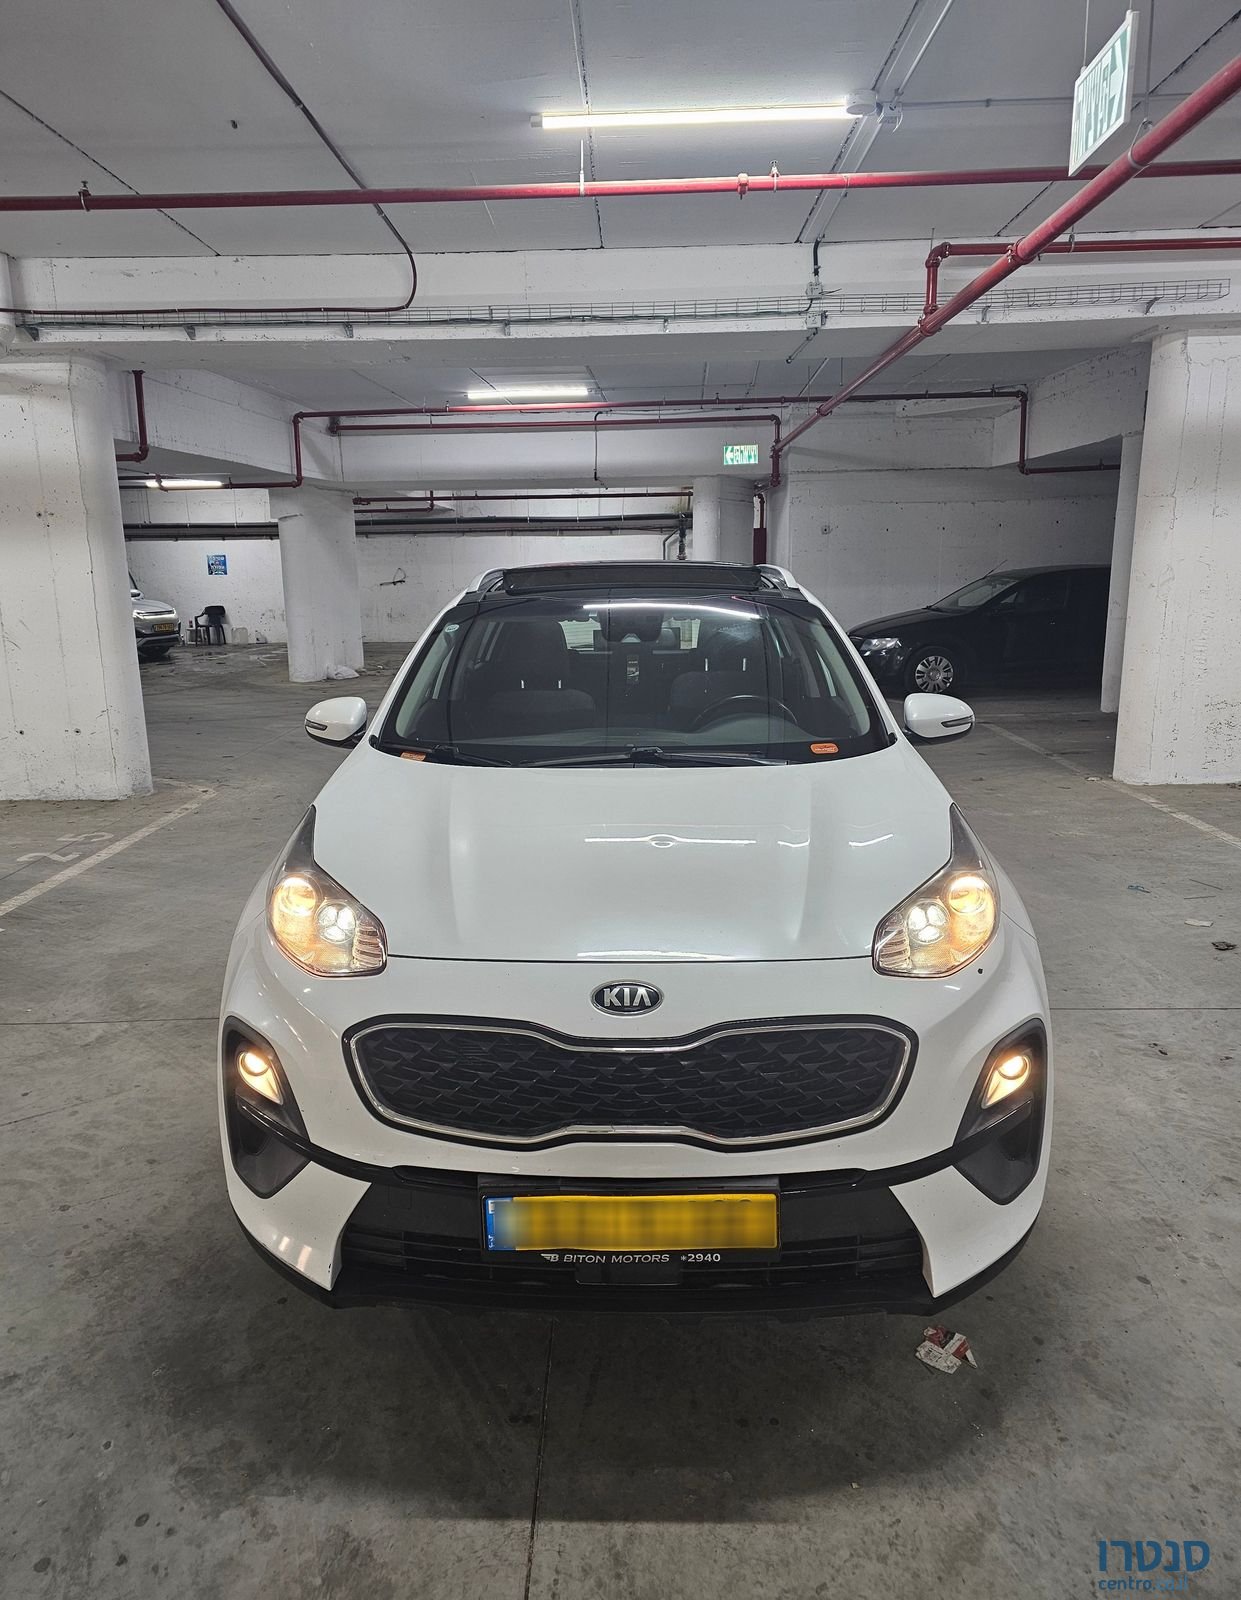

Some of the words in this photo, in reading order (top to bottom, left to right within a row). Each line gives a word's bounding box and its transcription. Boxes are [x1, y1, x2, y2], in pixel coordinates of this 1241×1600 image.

[603, 987, 651, 1007] KIA
[563, 1254, 606, 1263] BITON
[611, 1254, 670, 1263] MOTORS
